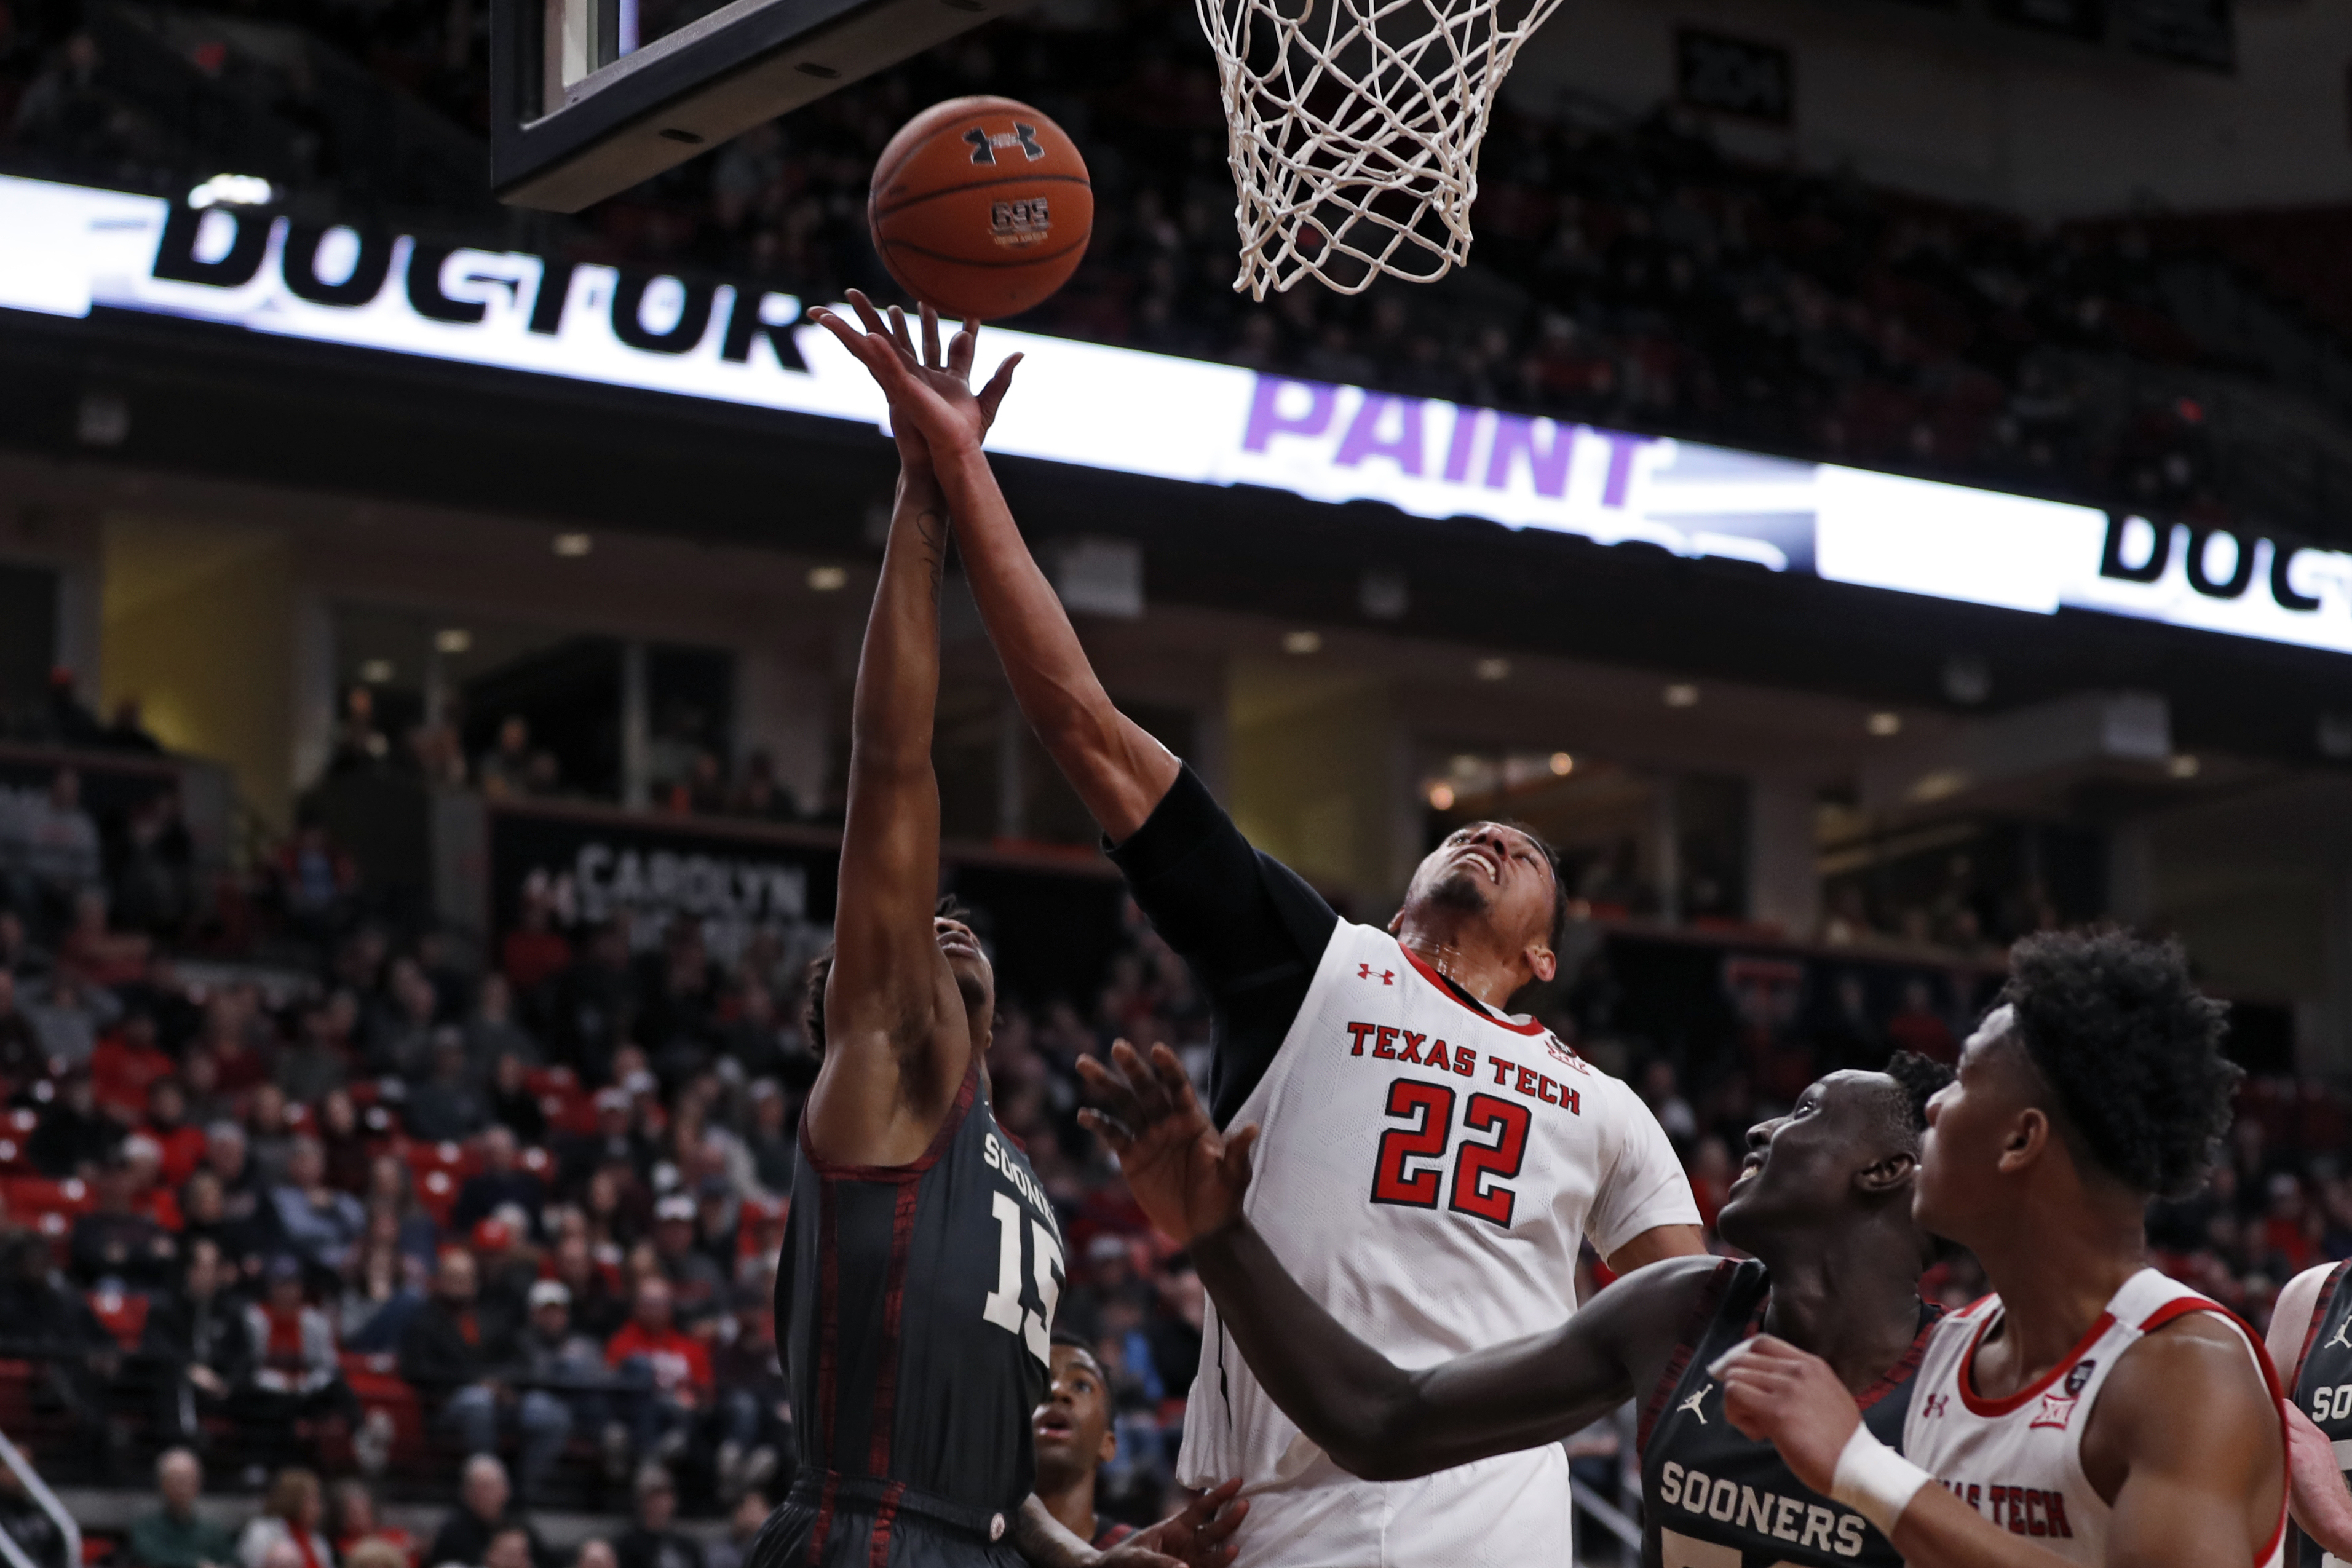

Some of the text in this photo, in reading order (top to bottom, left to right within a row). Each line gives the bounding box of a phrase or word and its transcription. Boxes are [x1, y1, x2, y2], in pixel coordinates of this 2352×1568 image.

[152, 198, 813, 373] DOCTOR
[1241, 372, 1665, 509] PAINT
[1348, 1021, 1580, 1115] TEXAS TECH
[984, 1133, 1064, 1249] SOONE
[1370, 1077, 1532, 1229] 22
[983, 1190, 1066, 1369] 15
[1661, 1460, 1866, 1557] SOONERS
[1989, 1484, 2073, 1538] TECH
